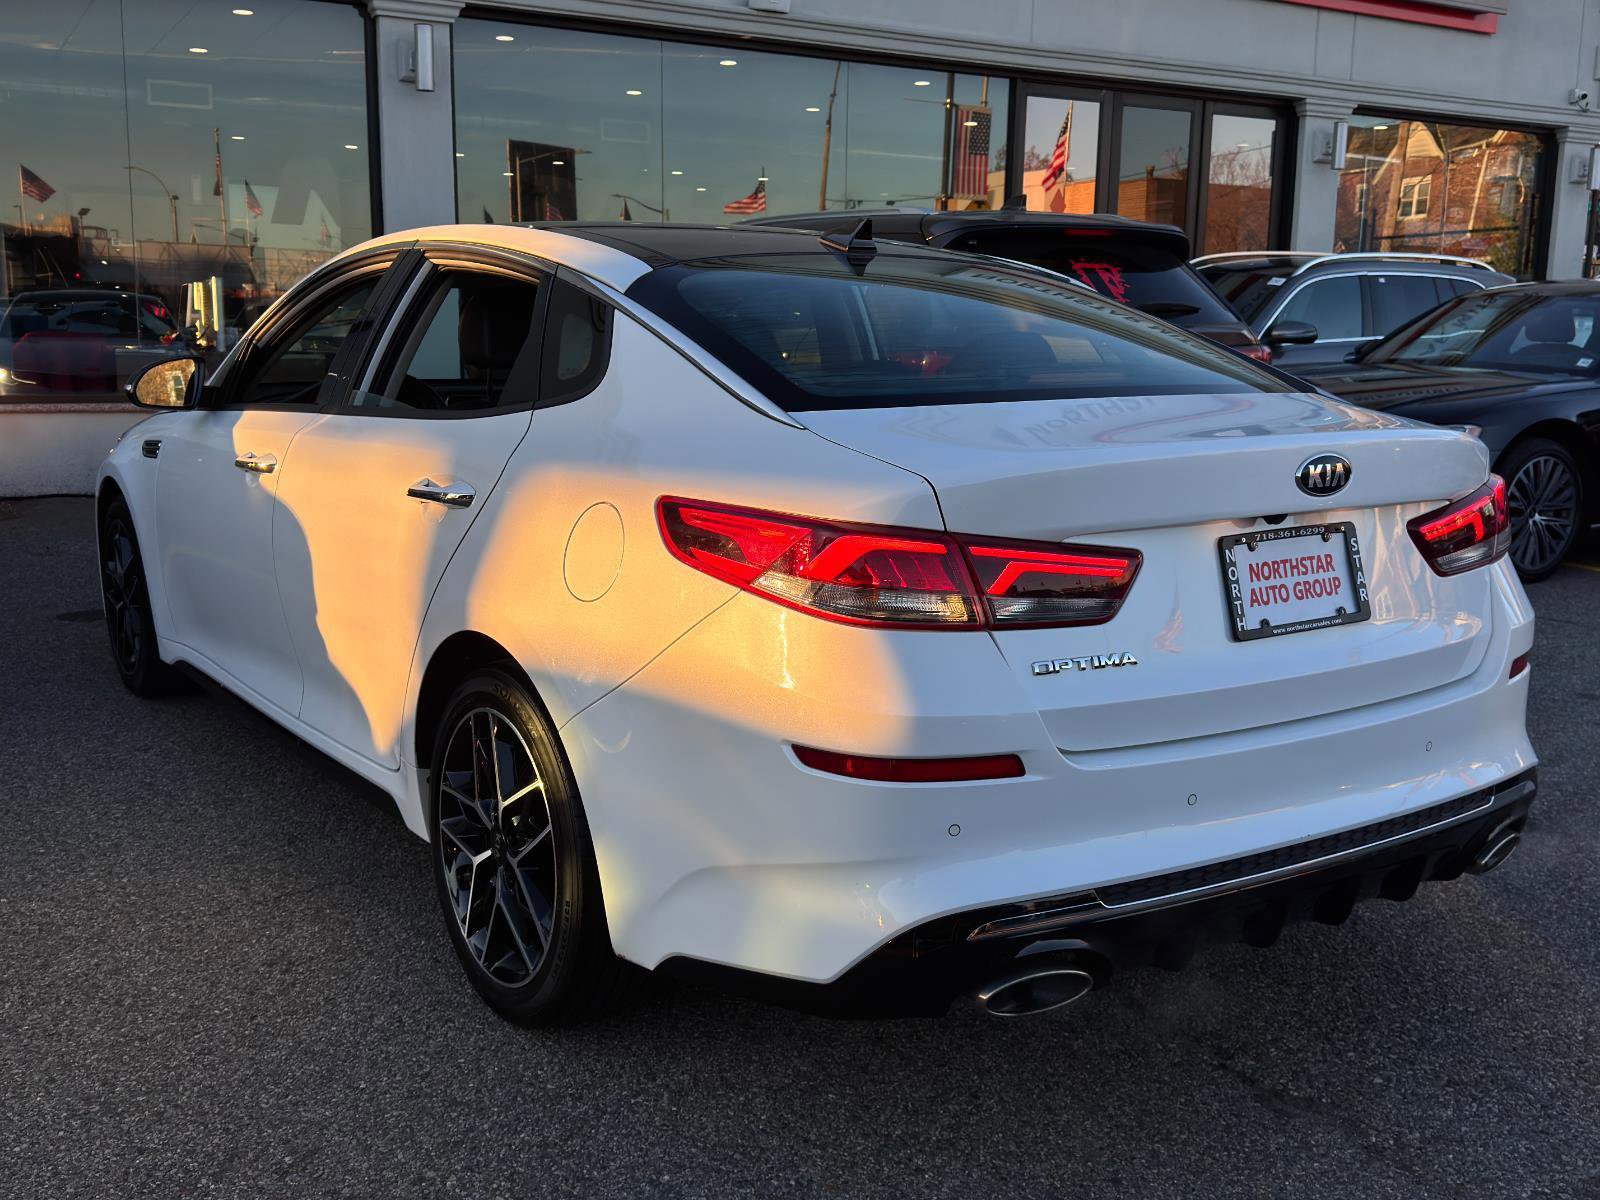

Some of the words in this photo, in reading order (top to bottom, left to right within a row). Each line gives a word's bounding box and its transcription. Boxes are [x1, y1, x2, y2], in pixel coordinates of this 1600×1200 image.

[1308, 463, 1346, 488] KIA
[1255, 526, 1325, 541] 718-361-6299
[1248, 553, 1336, 583] NORTHSTAR
[1350, 536, 1369, 602] STAR
[1225, 548, 1247, 632] NORTH
[1249, 583, 1290, 608] AUTO
[1293, 576, 1342, 601] GROUP
[1031, 651, 1138, 676] OPTIMA
